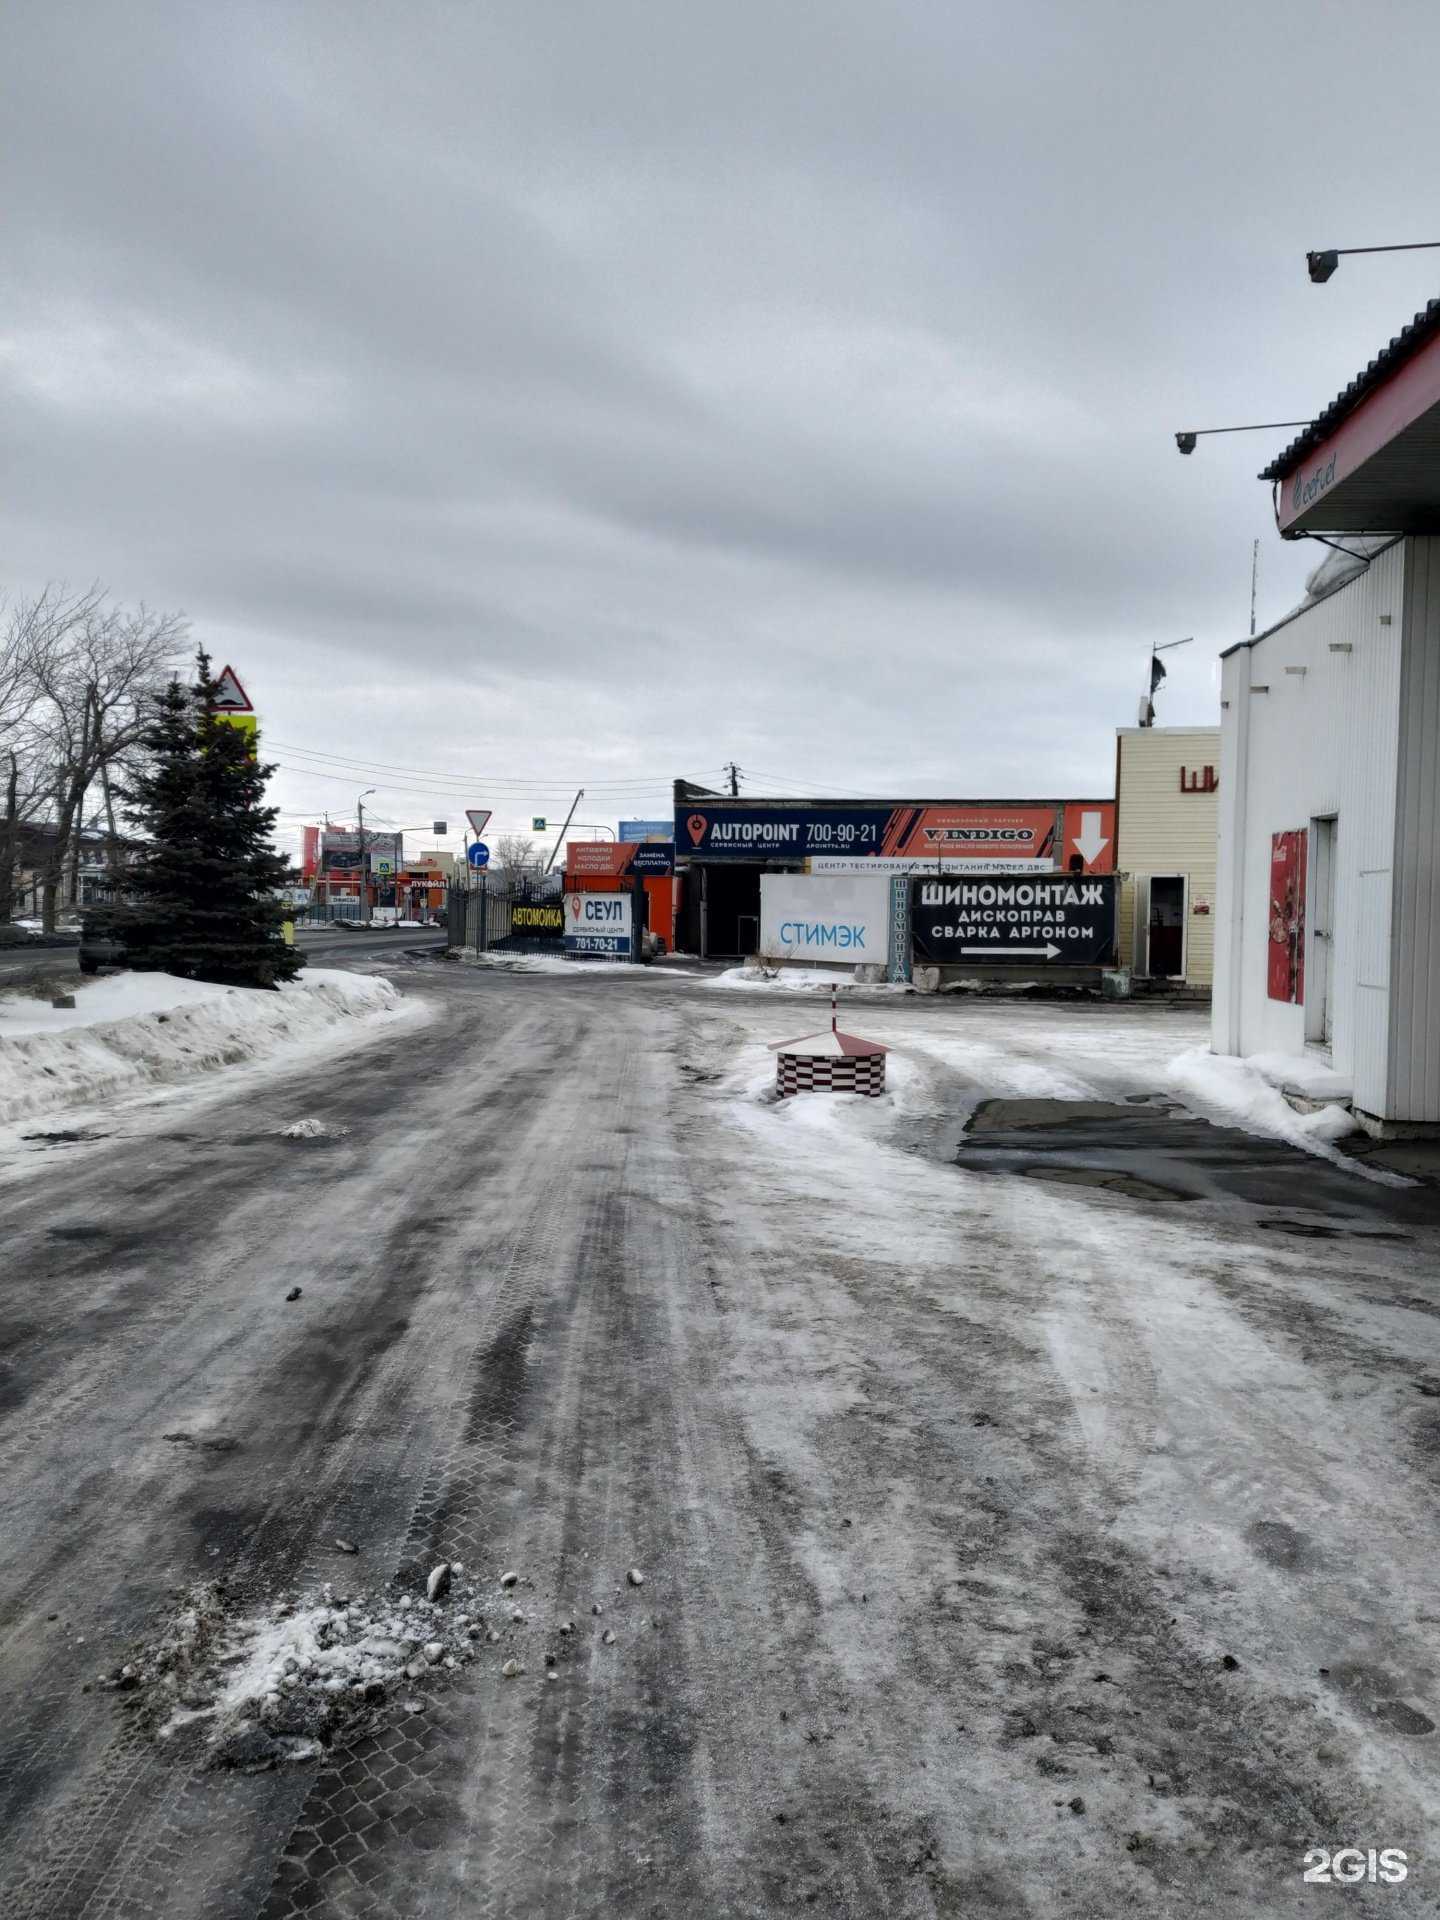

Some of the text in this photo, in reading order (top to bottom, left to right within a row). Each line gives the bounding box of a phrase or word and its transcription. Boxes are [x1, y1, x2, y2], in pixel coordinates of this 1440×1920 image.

[711, 824, 876, 842] AUTOPOINT 700-90-21
[923, 828, 1034, 841] WINDIGO
[921, 884, 1105, 906] ШИНОМОНТАЖ
[511, 905, 563, 927] АВТОМОЙКА
[586, 901, 623, 921] СЕУЛ
[958, 910, 1066, 923] ДИСКОПРАВ
[780, 922, 866, 949] СТИМЭК
[931, 926, 1094, 939] СВАРКА АРГОНОМ
